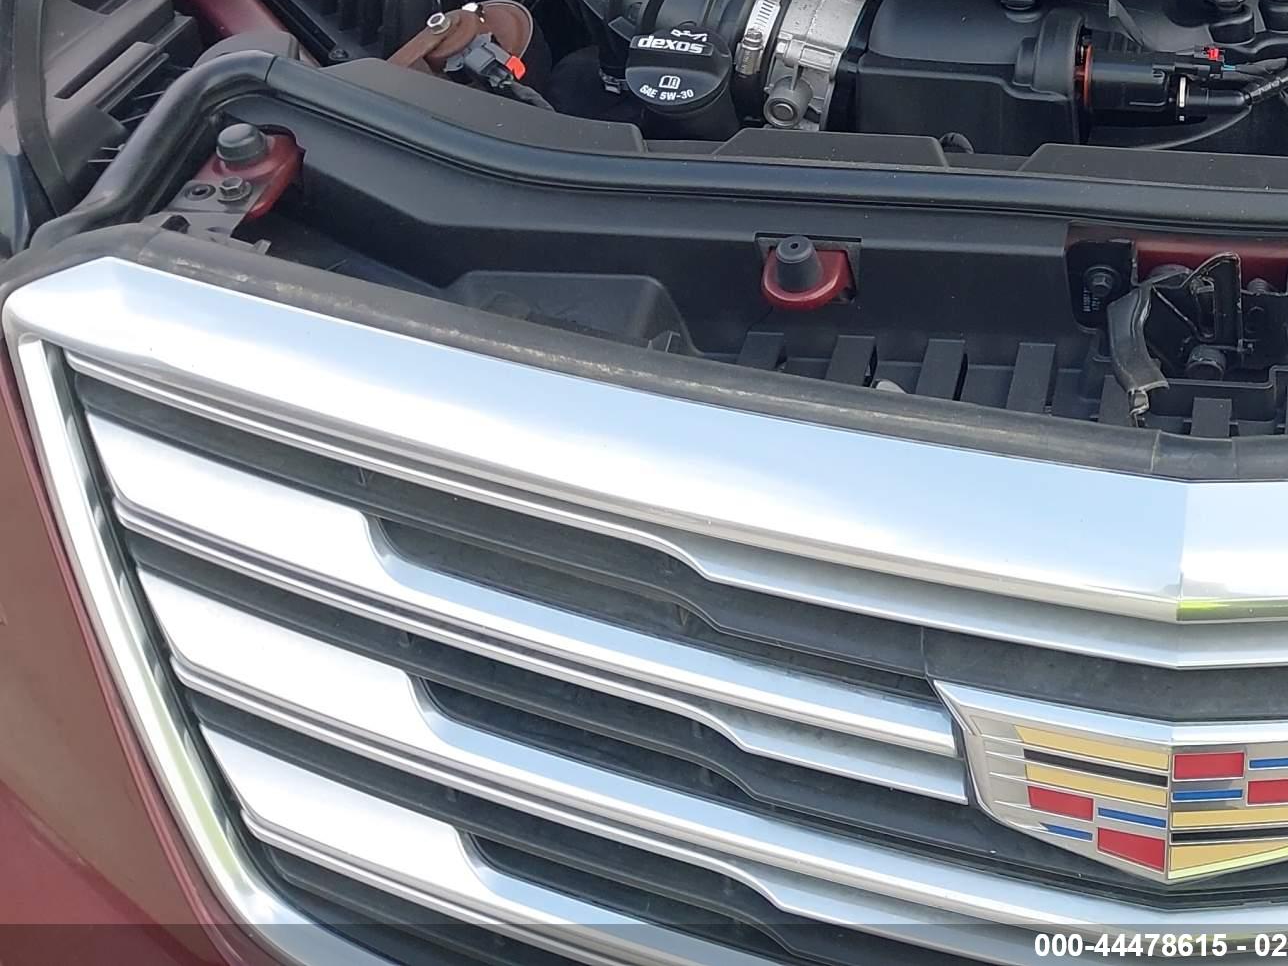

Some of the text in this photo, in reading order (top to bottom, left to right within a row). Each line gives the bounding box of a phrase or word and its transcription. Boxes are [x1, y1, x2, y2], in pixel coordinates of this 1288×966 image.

[637, 35, 707, 54] dexos
[640, 84, 694, 100] SAE 5W-30
